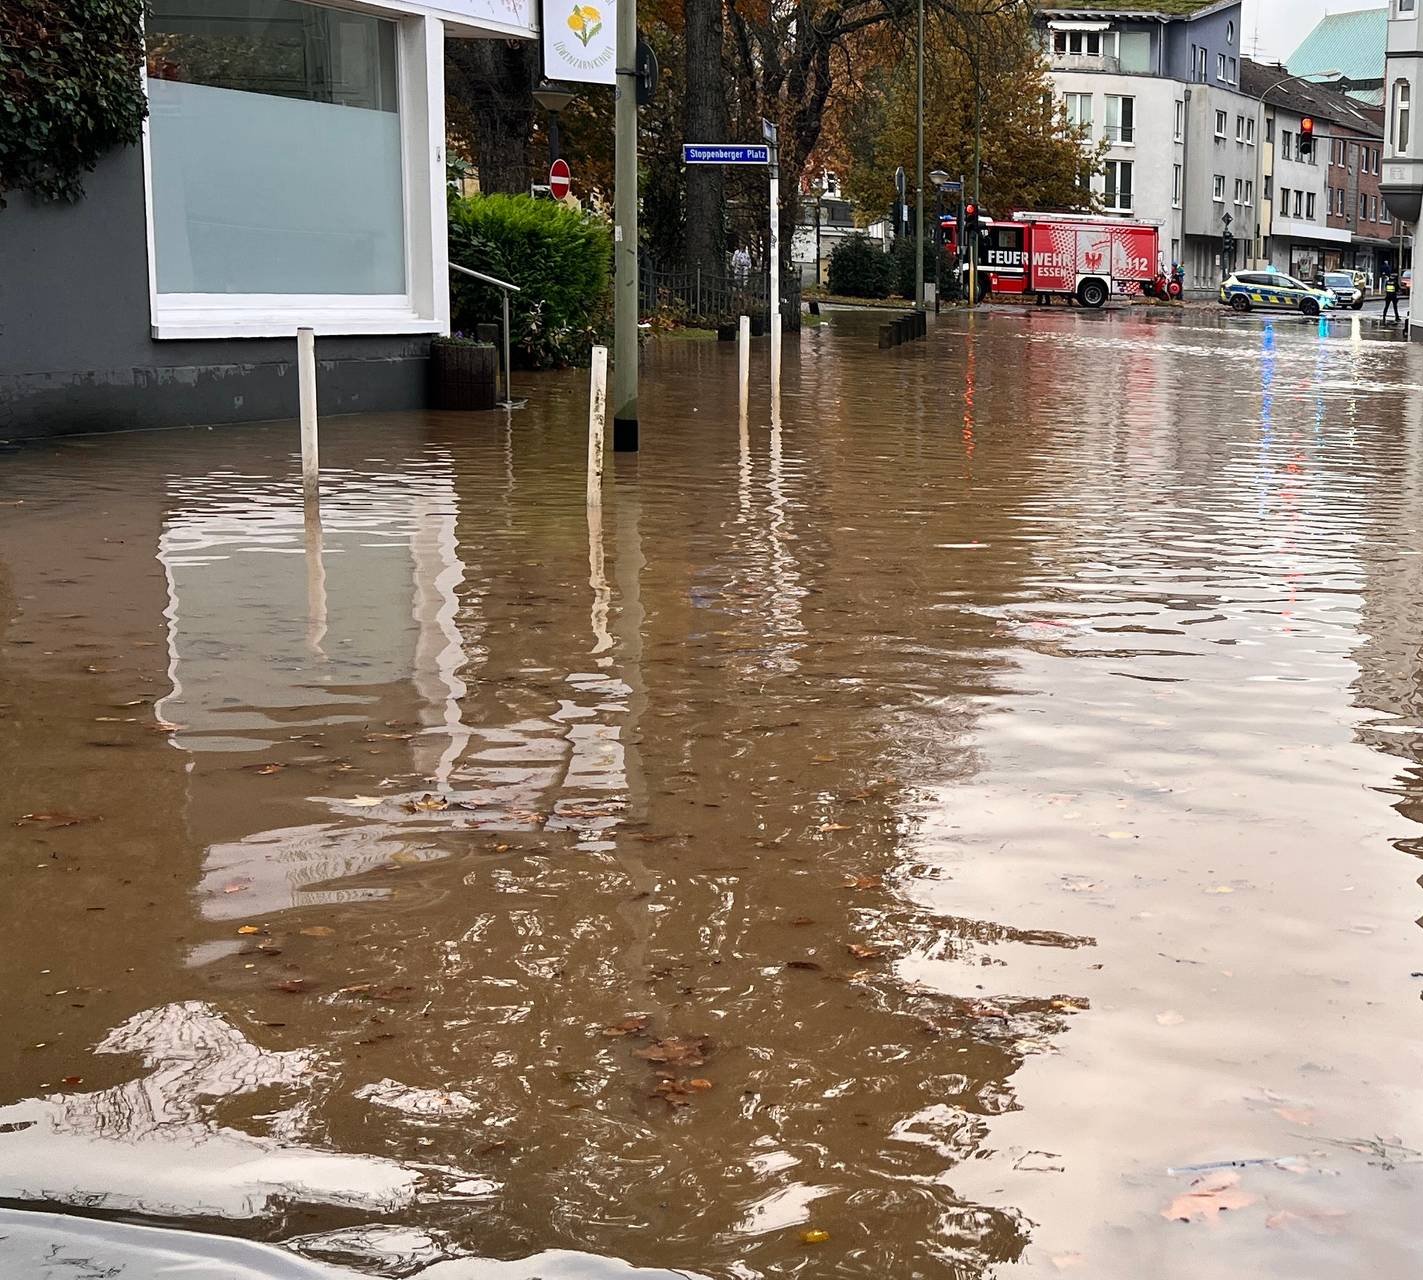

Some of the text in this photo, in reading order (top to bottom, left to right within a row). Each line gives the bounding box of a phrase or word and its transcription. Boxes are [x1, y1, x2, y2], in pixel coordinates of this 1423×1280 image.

[690, 149, 765, 161] Stoppenberger Platz
[1127, 257, 1148, 271] 112
[1037, 267, 1068, 278] ESSEN
